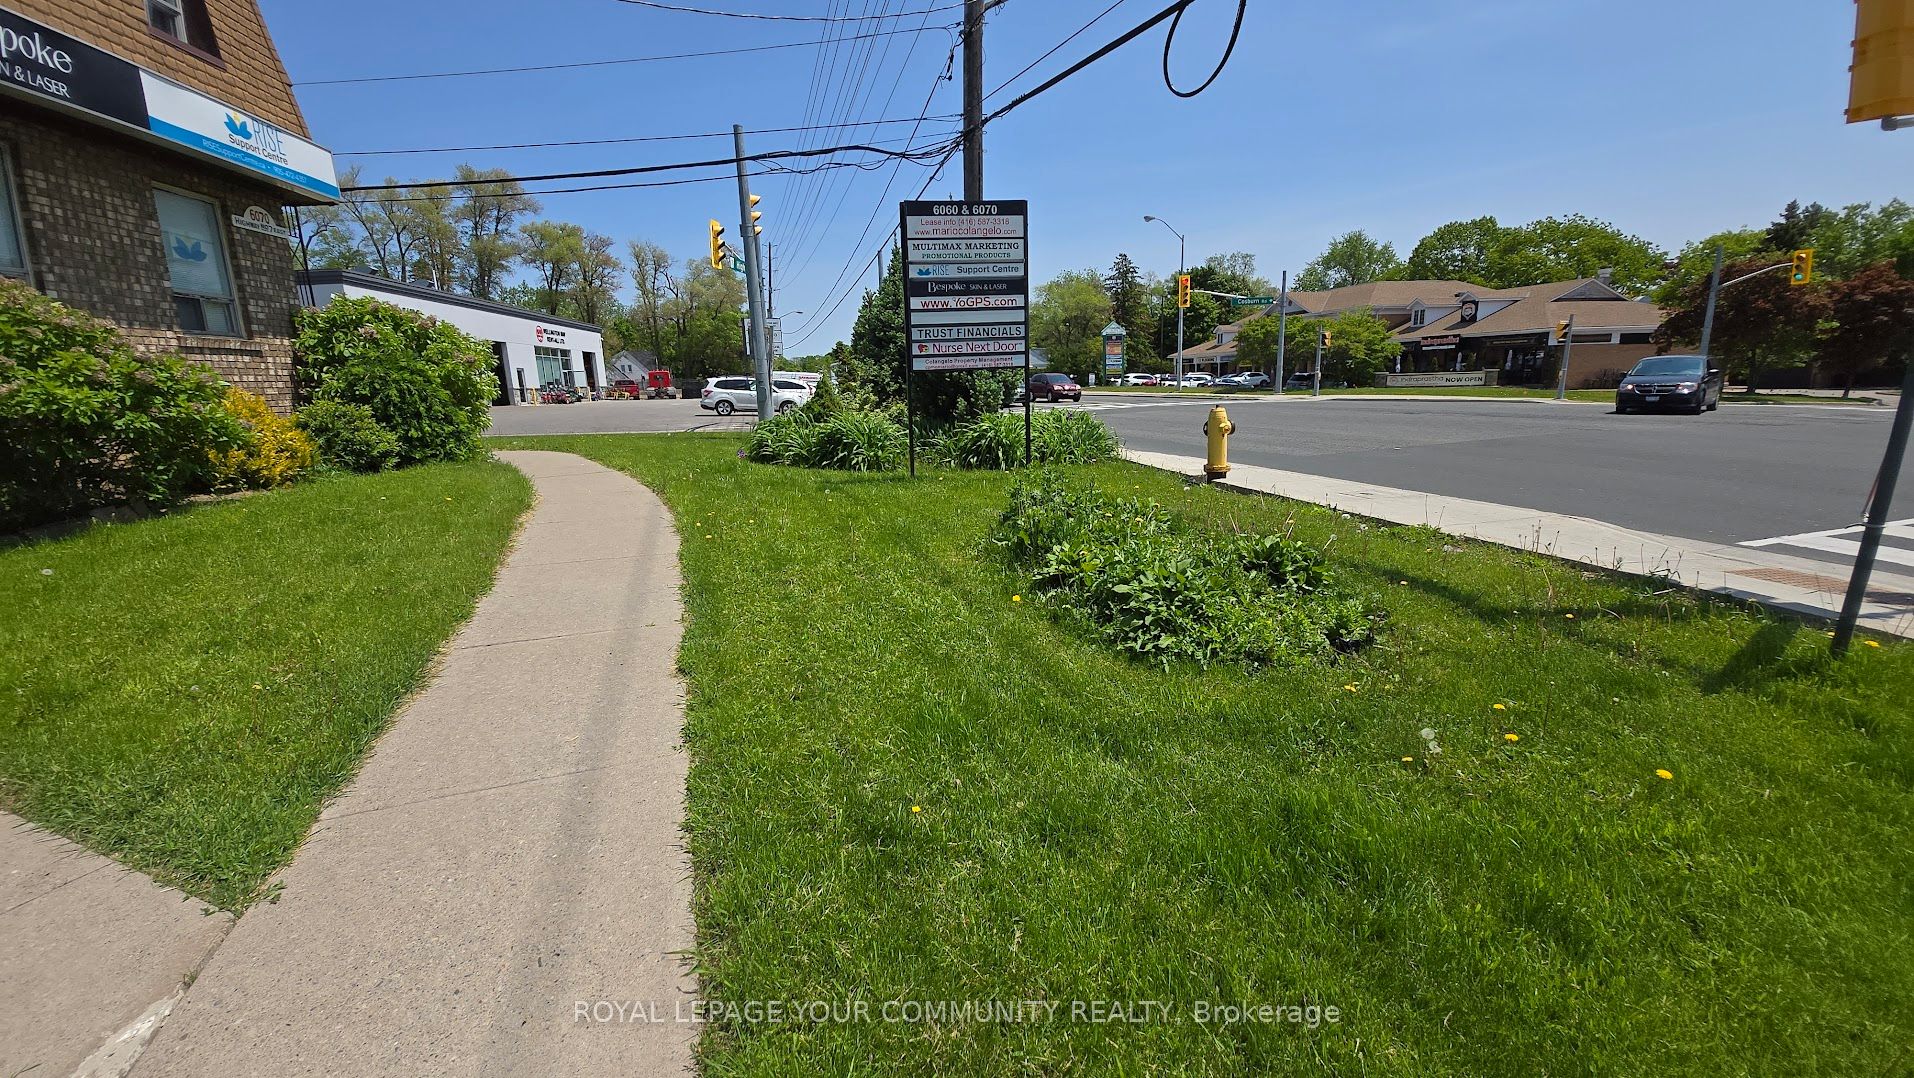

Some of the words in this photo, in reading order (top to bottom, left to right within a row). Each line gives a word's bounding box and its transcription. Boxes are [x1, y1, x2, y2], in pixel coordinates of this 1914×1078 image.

[14, 65, 25, 81] &
[27, 70, 70, 98] LASER
[252, 120, 286, 156] RISE
[228, 134, 260, 155] Support
[262, 148, 289, 165] Centre
[933, 205, 958, 215] 6060
[961, 205, 970, 215] &
[972, 205, 998, 215] 6070
[250, 209, 270, 224] 6070
[920, 218, 942, 226] Lease
[943, 218, 956, 226] info
[958, 218, 976, 226] (416)
[914, 226, 1017, 237] www.mariocolangelo.com
[912, 243, 962, 251] MULTIMAX
[965, 242, 1019, 250] MARKETING
[932, 265, 950, 276] RISE
[956, 265, 990, 275] Support
[992, 265, 1019, 273] Centre
[928, 281, 967, 293] Bespoke
[920, 296, 1018, 309] www.YoGPS.com
[917, 328, 954, 338] TRUST
[957, 326, 1021, 337] FINANCIALS
[932, 342, 963, 353] Nurse
[966, 342, 991, 352] Next
[993, 341, 1018, 351] Door
